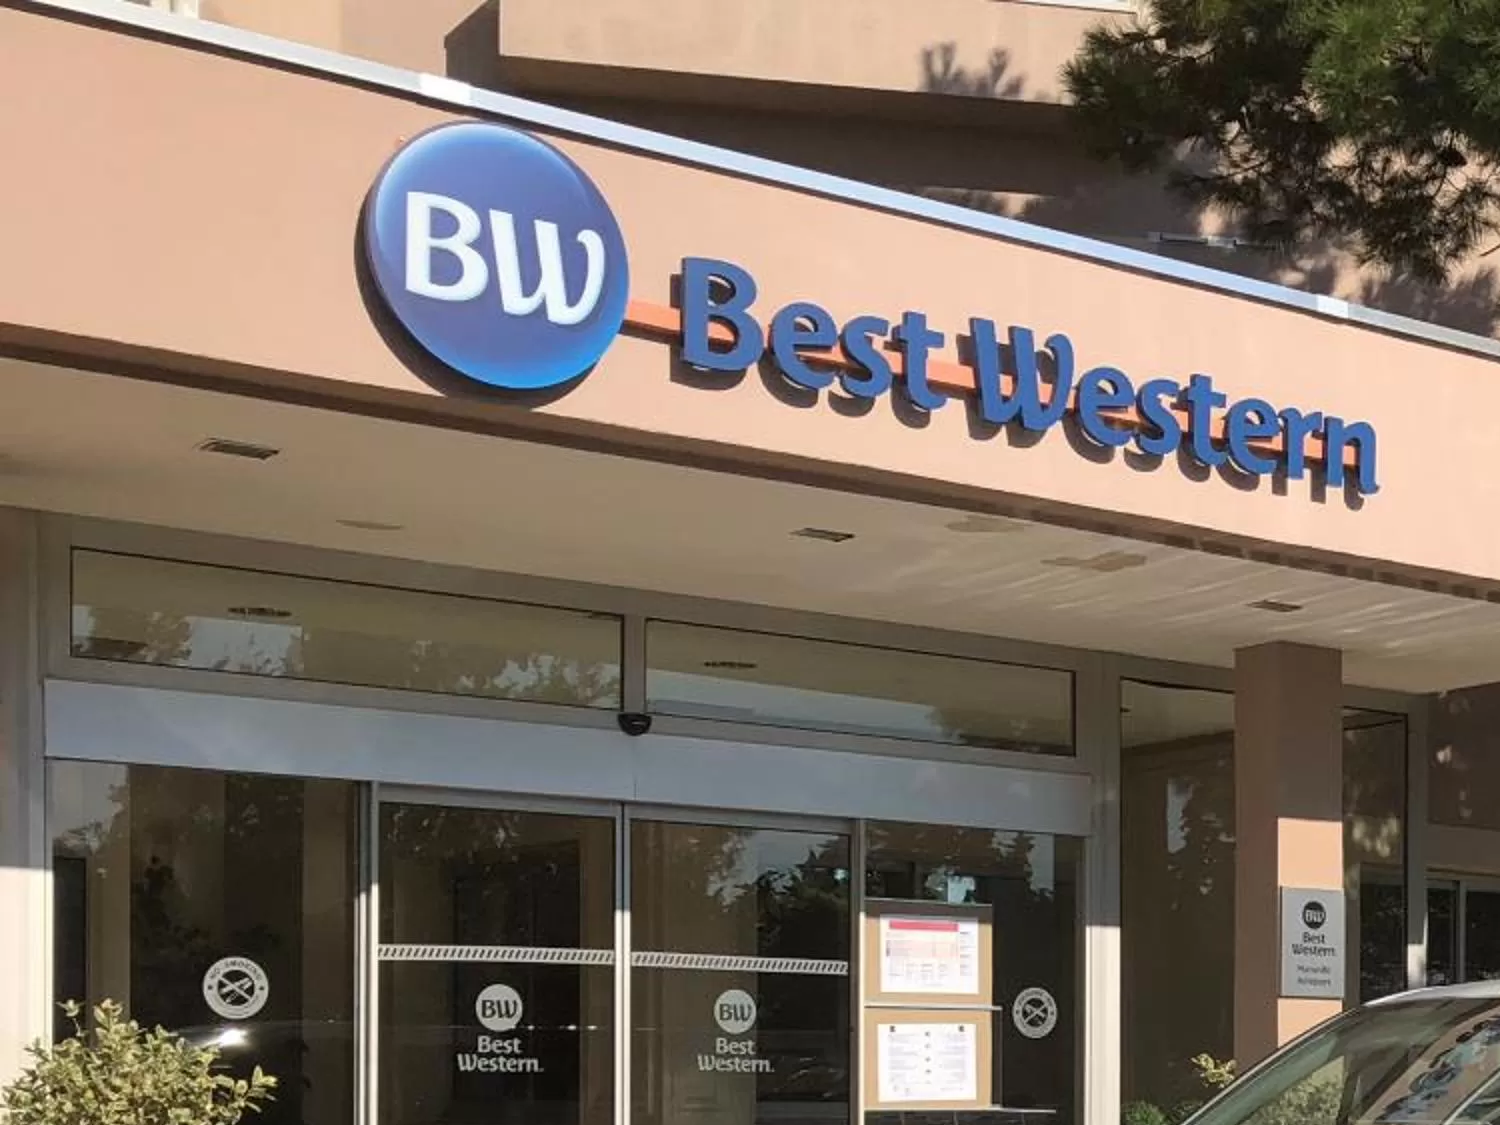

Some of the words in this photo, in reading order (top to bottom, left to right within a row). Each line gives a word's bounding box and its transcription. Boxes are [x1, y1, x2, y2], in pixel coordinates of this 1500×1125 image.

[405, 191, 605, 325] BW
[680, 256, 949, 411] Best
[969, 317, 1381, 496] Western
[481, 999, 518, 1019] BW
[719, 1003, 753, 1022] BW
[477, 1035, 522, 1054] Best
[715, 1037, 757, 1055] Best
[457, 1053, 540, 1073] Western
[697, 1054, 771, 1073] Western
